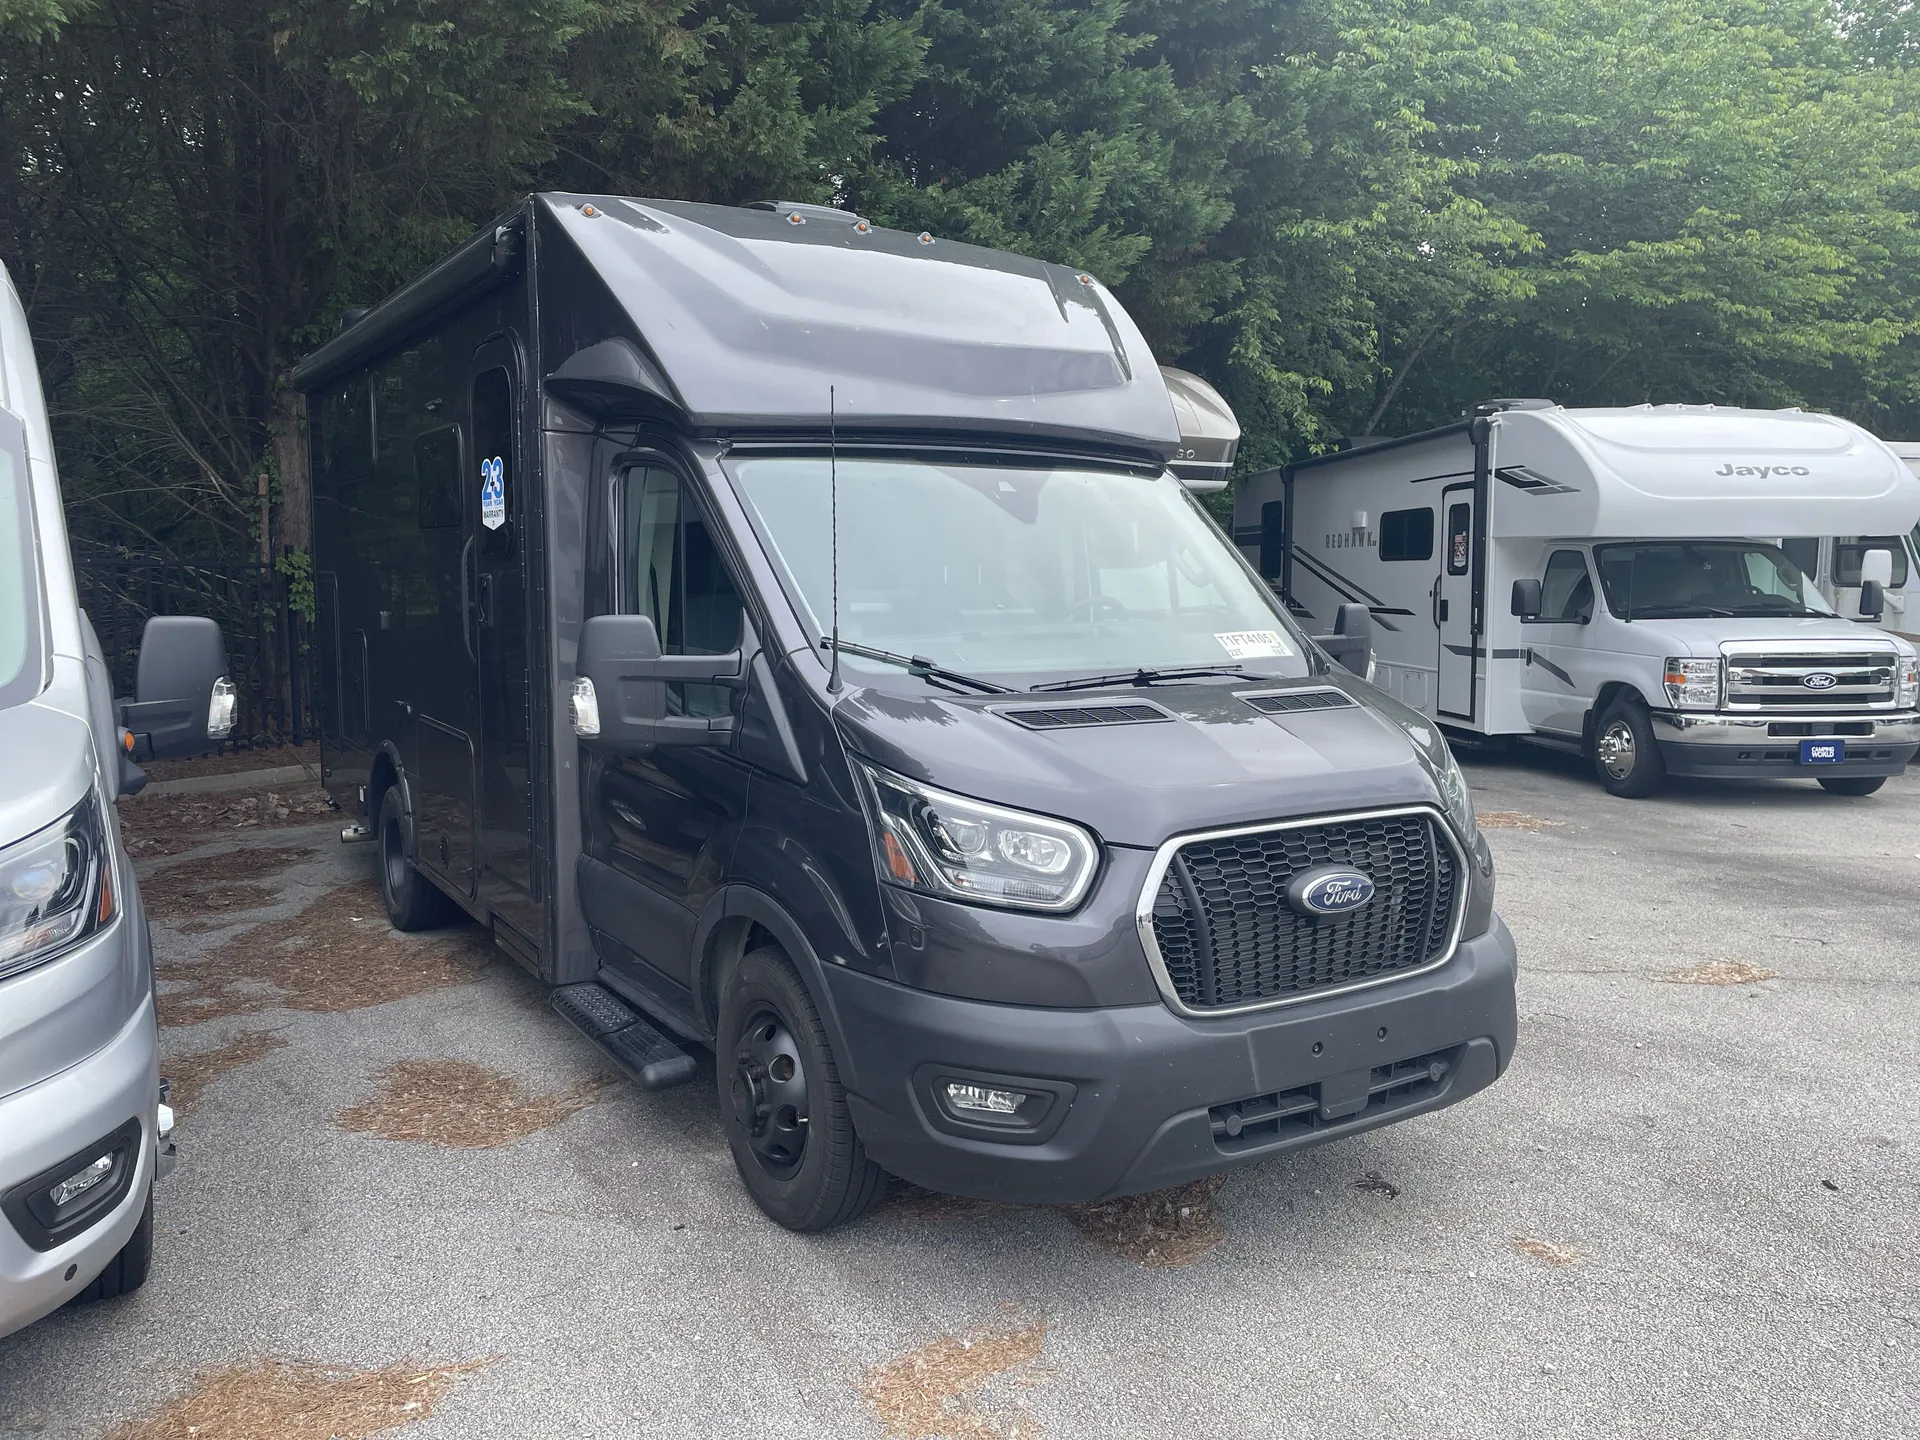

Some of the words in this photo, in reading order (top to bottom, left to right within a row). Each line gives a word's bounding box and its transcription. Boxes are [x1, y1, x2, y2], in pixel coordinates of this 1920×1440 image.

[1715, 463, 1810, 479] Jayco
[483, 509, 504, 519] WARRANTY
[1325, 531, 1373, 548] REDHAWK
[1809, 676, 1831, 686] Ford
[1323, 880, 1362, 905] Ford
